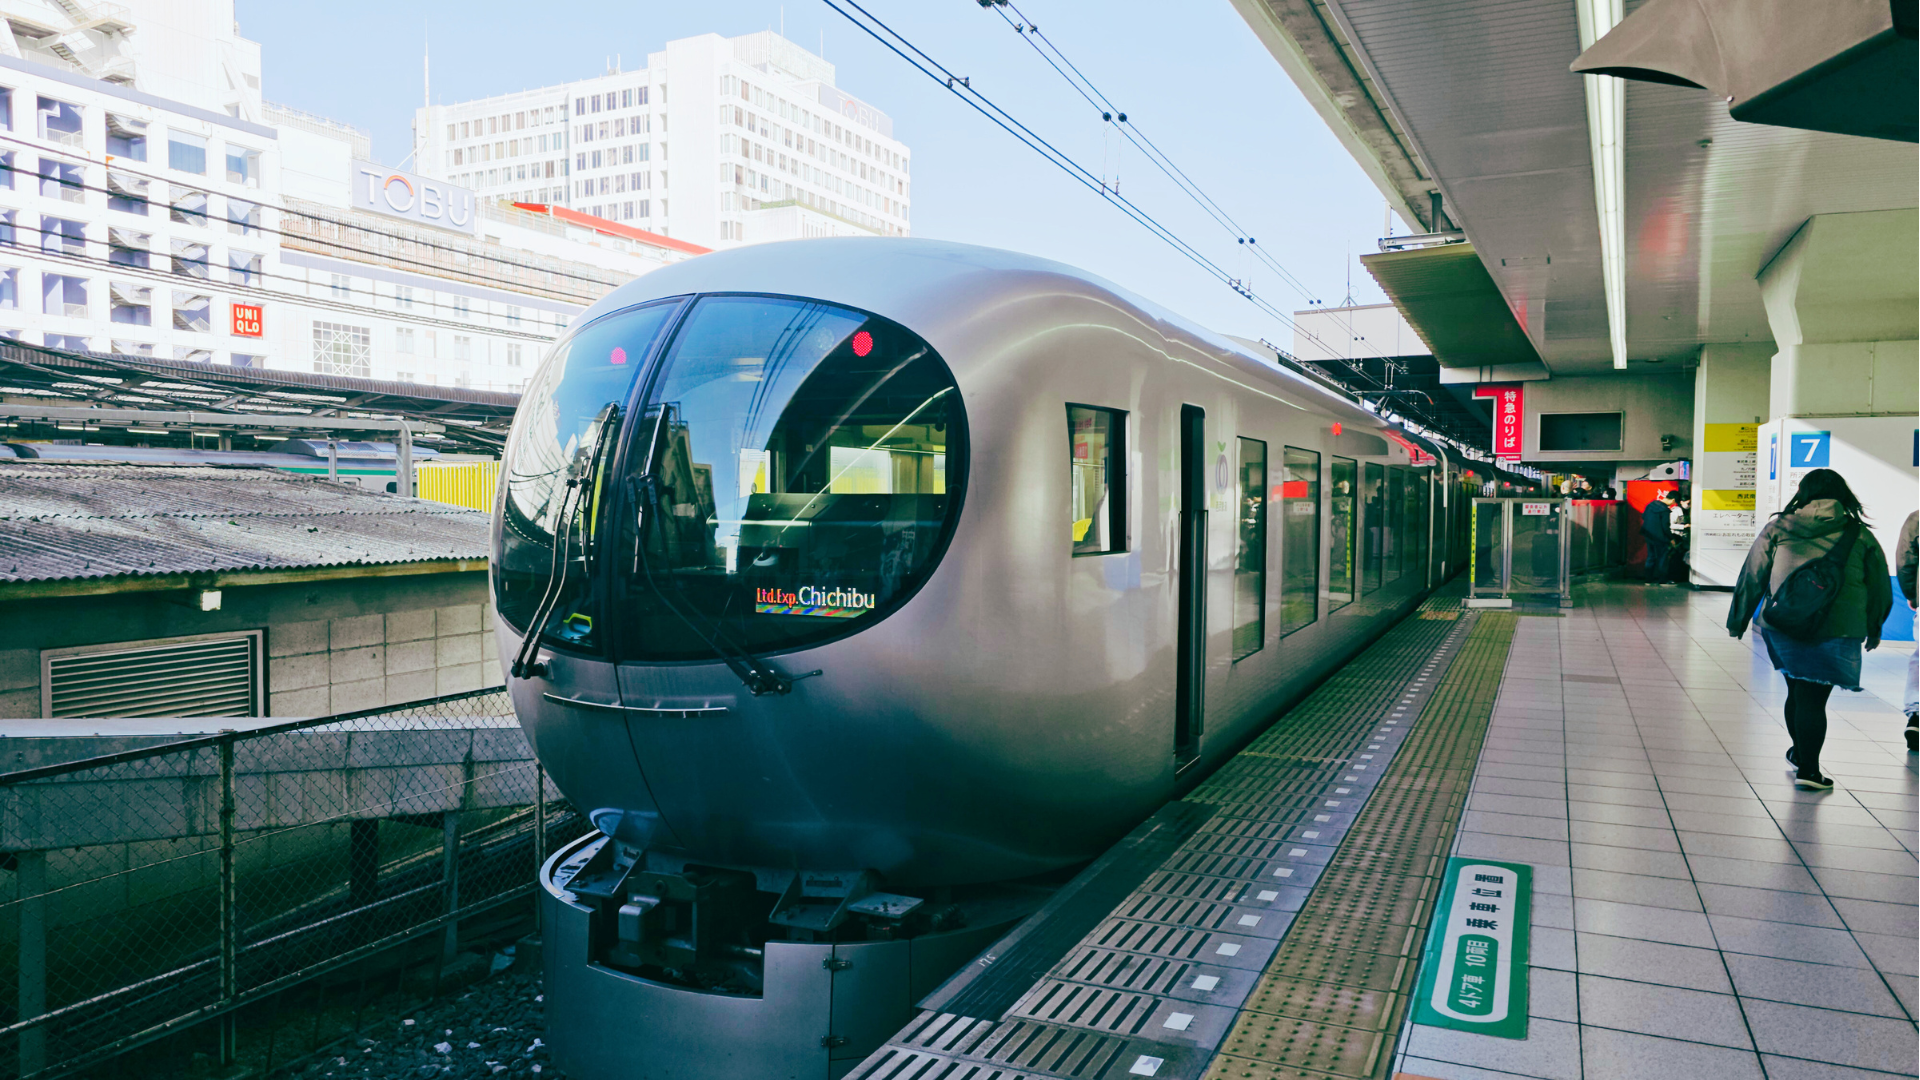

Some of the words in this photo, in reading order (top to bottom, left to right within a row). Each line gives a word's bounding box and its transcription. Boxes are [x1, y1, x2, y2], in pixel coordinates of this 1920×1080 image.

[837, 95, 879, 133] TOBU
[360, 166, 469, 226] TOBU
[236, 307, 257, 321] UNI
[236, 320, 260, 333] QLO
[1503, 390, 1517, 448] 特急のりば
[1800, 438, 1821, 463] 7
[756, 587, 799, 608] Ltd.Exp.
[799, 586, 875, 609] Chichibu
[1466, 873, 1504, 930] 乗車位置
[1464, 939, 1490, 967] 10両目
[1458, 974, 1486, 1009] 4ドア車
